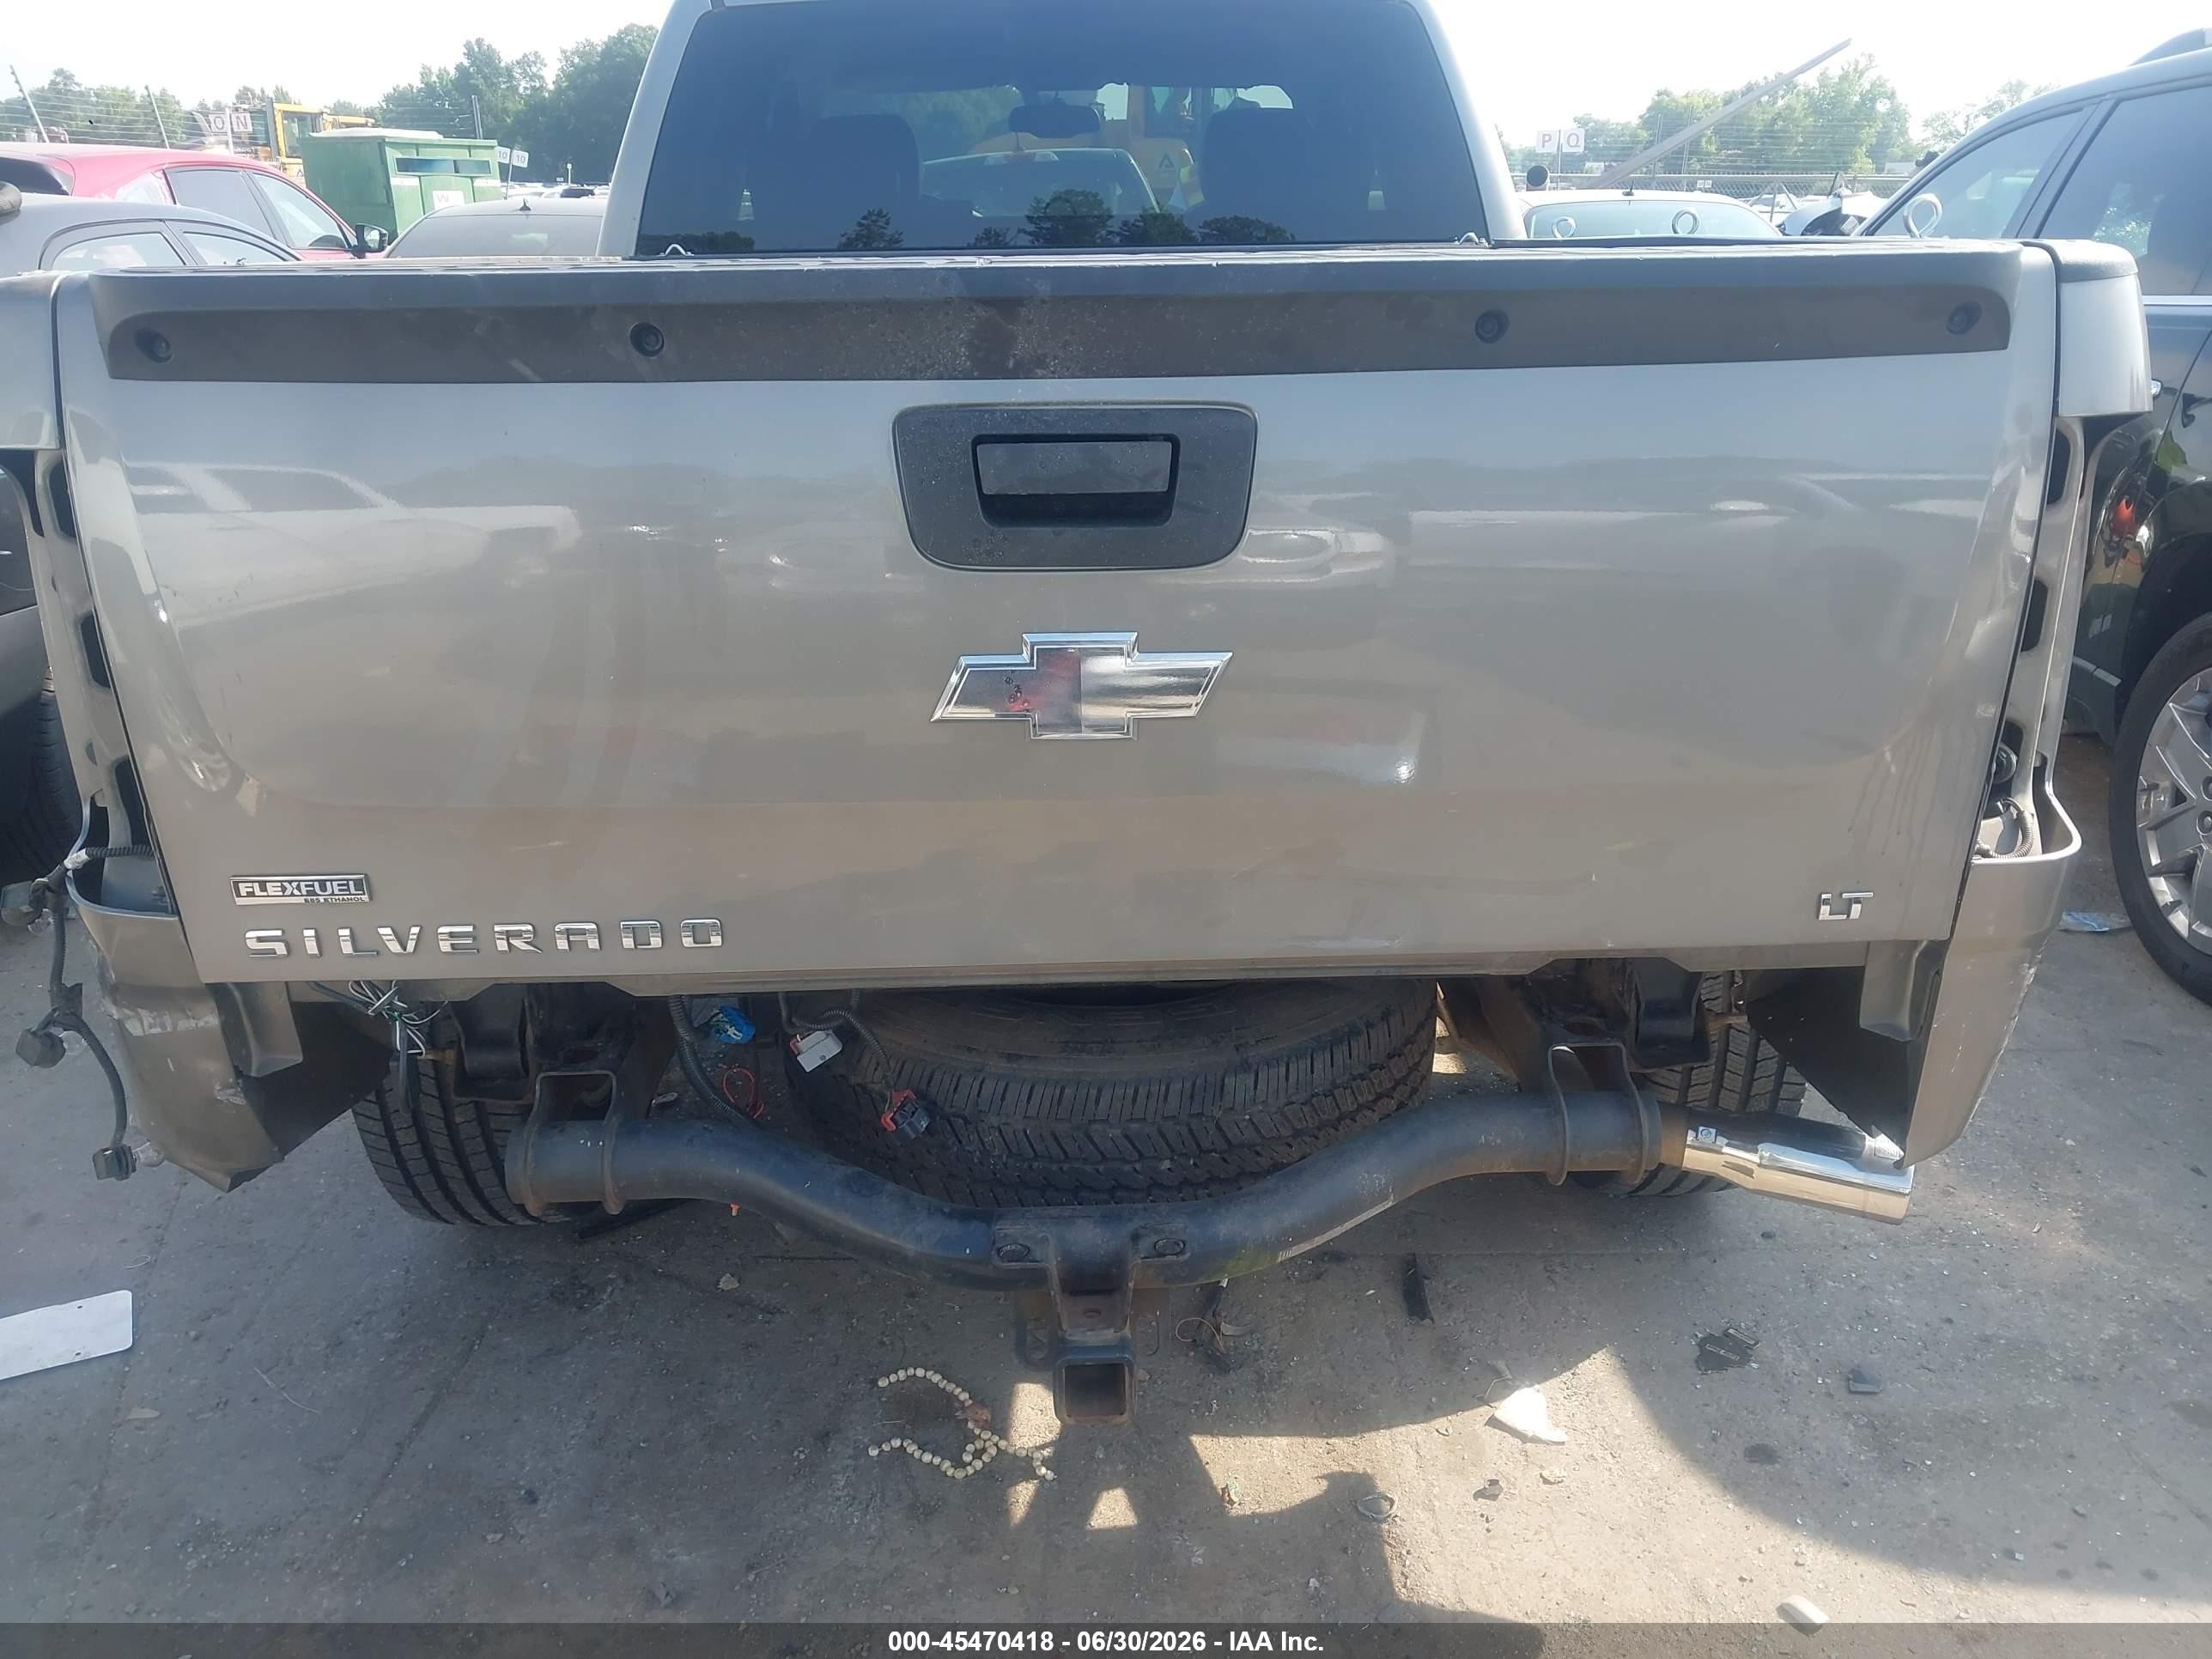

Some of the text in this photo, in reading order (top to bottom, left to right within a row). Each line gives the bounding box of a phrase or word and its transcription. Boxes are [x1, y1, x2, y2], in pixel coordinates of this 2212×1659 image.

[235, 115, 248, 130] N
[1541, 133, 1553, 149] P
[1566, 132, 1581, 148] Q
[497, 150, 508, 160] 10
[515, 155, 526, 165] 10
[238, 880, 364, 896] FLEXFUEL
[1818, 891, 1874, 921] LT
[245, 918, 724, 958] SILVERADO
